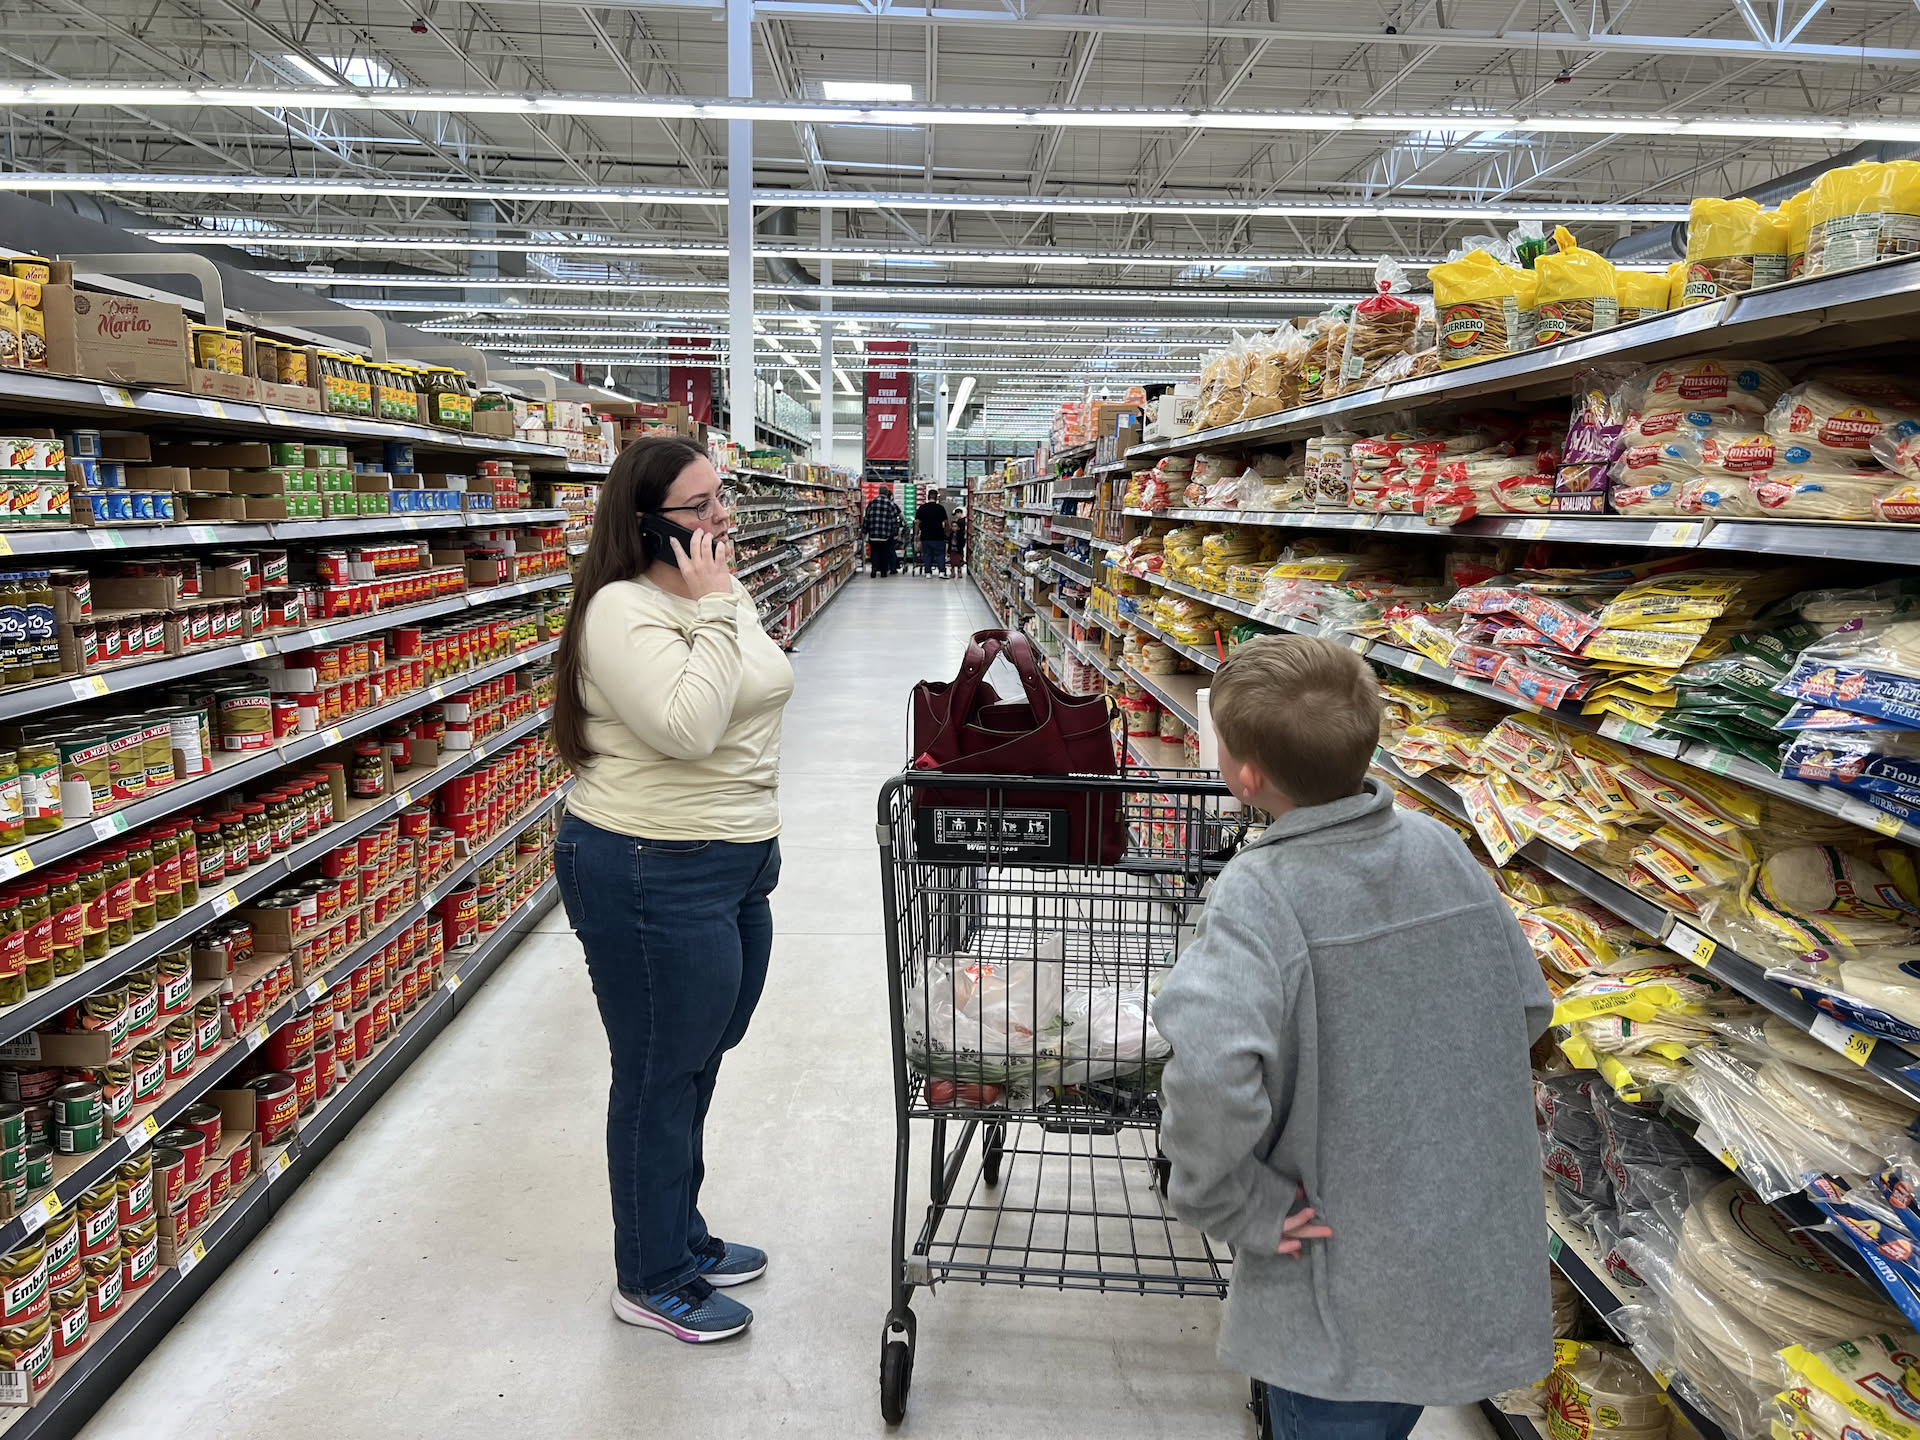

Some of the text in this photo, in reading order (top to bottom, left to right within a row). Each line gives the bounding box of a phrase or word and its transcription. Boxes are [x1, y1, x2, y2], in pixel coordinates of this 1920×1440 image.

[102, 300, 139, 315] Doña
[1729, 446, 1773, 459] mission
[1560, 496, 1592, 512] CHALUPAS
[1691, 943, 1711, 960] 2.51
[1845, 1034, 1869, 1055] 5.98
[47, 1231, 77, 1266] mbasa
